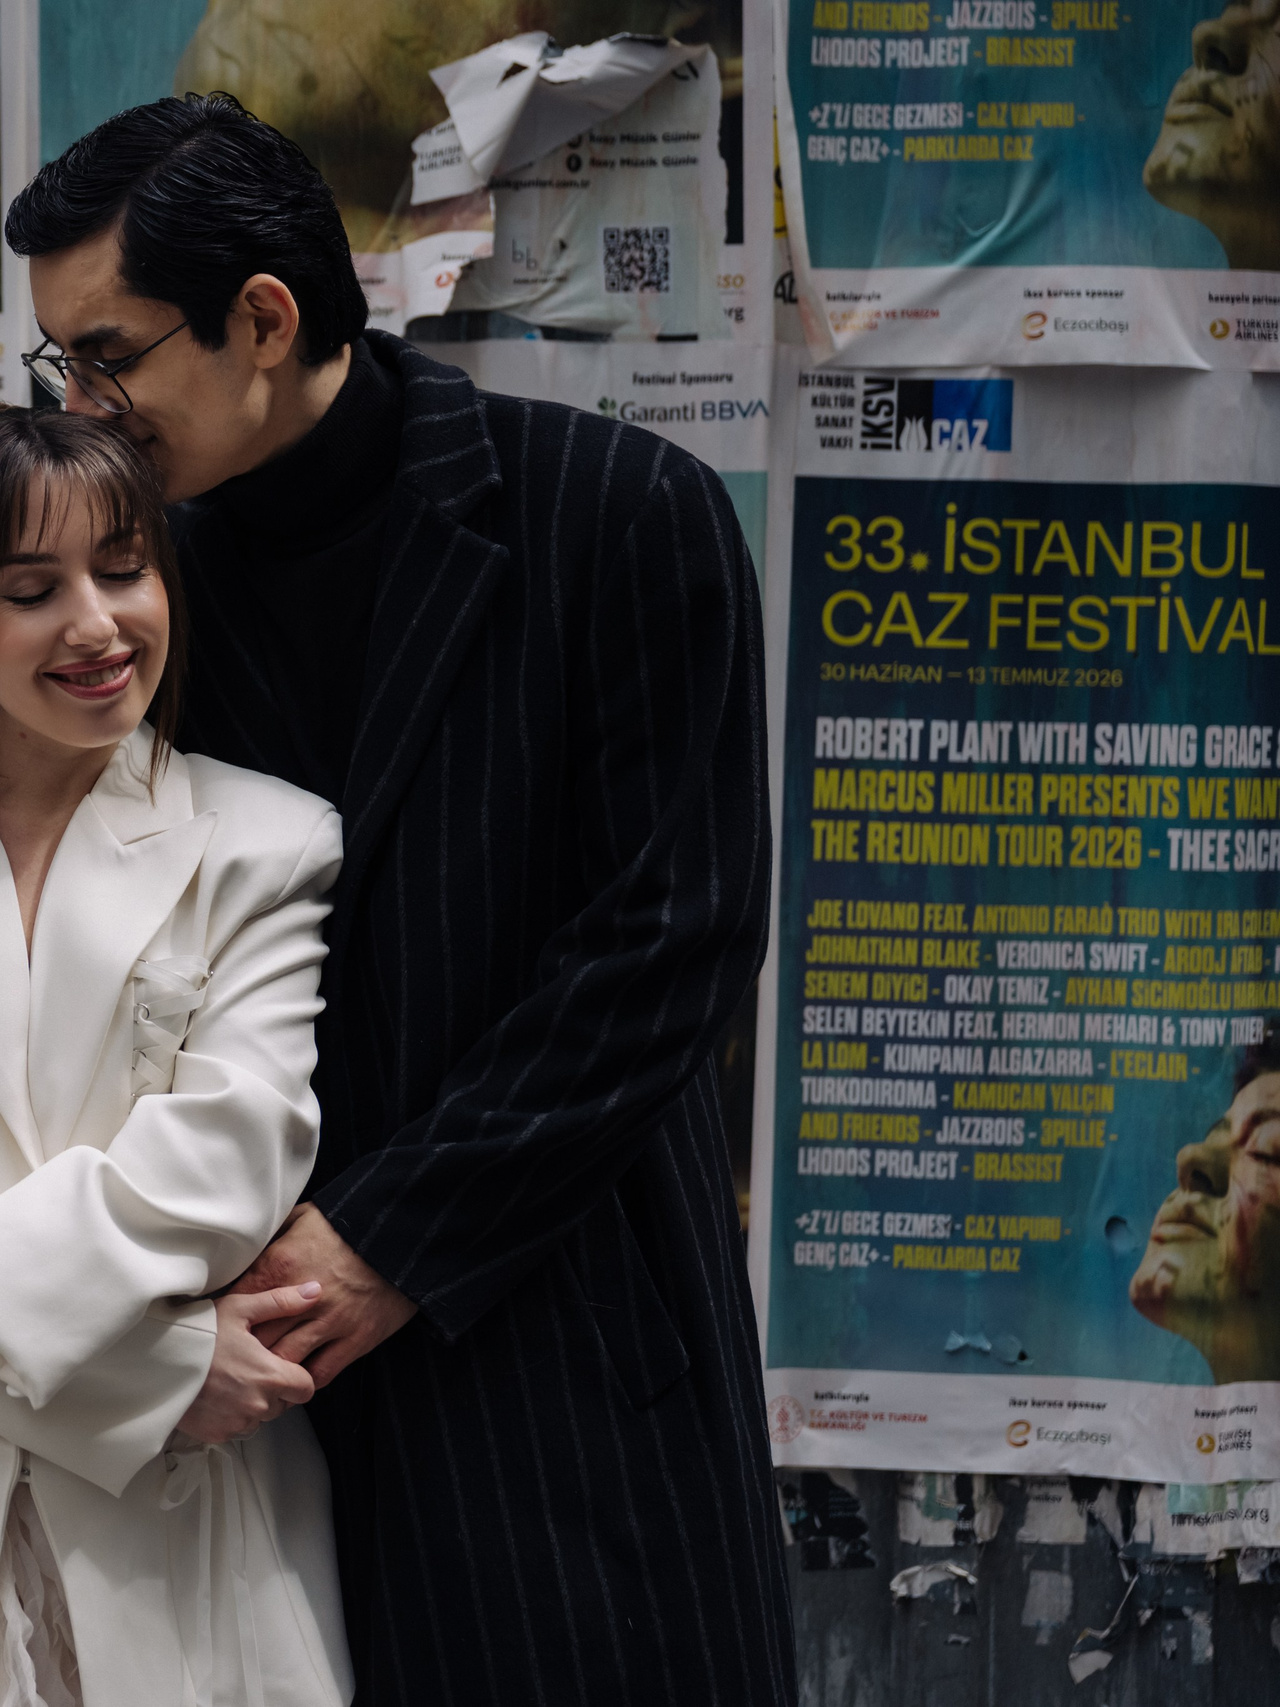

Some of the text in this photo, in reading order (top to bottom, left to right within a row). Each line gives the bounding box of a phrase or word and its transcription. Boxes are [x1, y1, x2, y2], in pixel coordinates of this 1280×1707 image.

[813, 0, 1036, 32] AND FRIENDS JAZZBOIS
[884, 36, 970, 69] PROJECT
[985, 36, 1076, 67] BRASSIST
[977, 103, 1007, 128] CAZ
[1003, 135, 1034, 161] CAZ
[633, 372, 676, 386] Festival
[620, 399, 769, 423] Garanti BBVA
[815, 414, 853, 428] SANAT
[931, 418, 989, 452] CAZ
[944, 501, 1265, 580] İSTANBUL
[821, 590, 969, 649] CAZ
[820, 659, 1123, 688] 30 HAZİRAN 13 TEMMUZ 2026
[815, 716, 1273, 769] ROBERT PLANT WITH SAVING GRACE
[813, 767, 1230, 820] MARCUS MILLER PRESENTS WE
[811, 819, 1231, 872] THE REUNION TOUR 2026 THEE
[807, 899, 1212, 939] JOE LOVANO FEAT. ANTONIO TRIO WITH
[806, 935, 1226, 975] JOHNATHAN BLAKE VERONICA SWIFT AROOJ
[805, 971, 868, 1000] SENEM
[944, 975, 994, 1004] OKAY
[997, 976, 1050, 1005] TEMİZ
[1065, 977, 1127, 1007] AYHAN
[803, 1005, 858, 1035] SELEN
[862, 1007, 950, 1039] BEYTEKİN
[954, 1010, 998, 1040] FEAT.
[1002, 1011, 1080, 1042] HERMON
[1084, 1013, 1158, 1045] MEHARI
[1161, 1016, 1176, 1046] &
[1179, 1017, 1227, 1047] TONY
[801, 1040, 824, 1069] LA
[827, 1041, 868, 1071] LOM
[883, 1043, 984, 1074] KUMPANIA
[988, 1045, 1094, 1077] ALGAZARRA
[801, 1077, 936, 1109] TURKODIROMA
[953, 1082, 1046, 1112] KAMUCAN
[799, 1112, 838, 1141] AND
[842, 1113, 919, 1143] FRIENDS
[936, 1116, 1025, 1146] JAZZBOIS
[798, 1147, 1064, 1182] LHODOS PROJECT BRASSIST
[841, 1211, 880, 1236] GECE
[965, 1216, 995, 1240] CAZ
[794, 1241, 836, 1270] GENÇ
[893, 1244, 986, 1272] PARKLARDA
[990, 1246, 1020, 1272] CAZ
